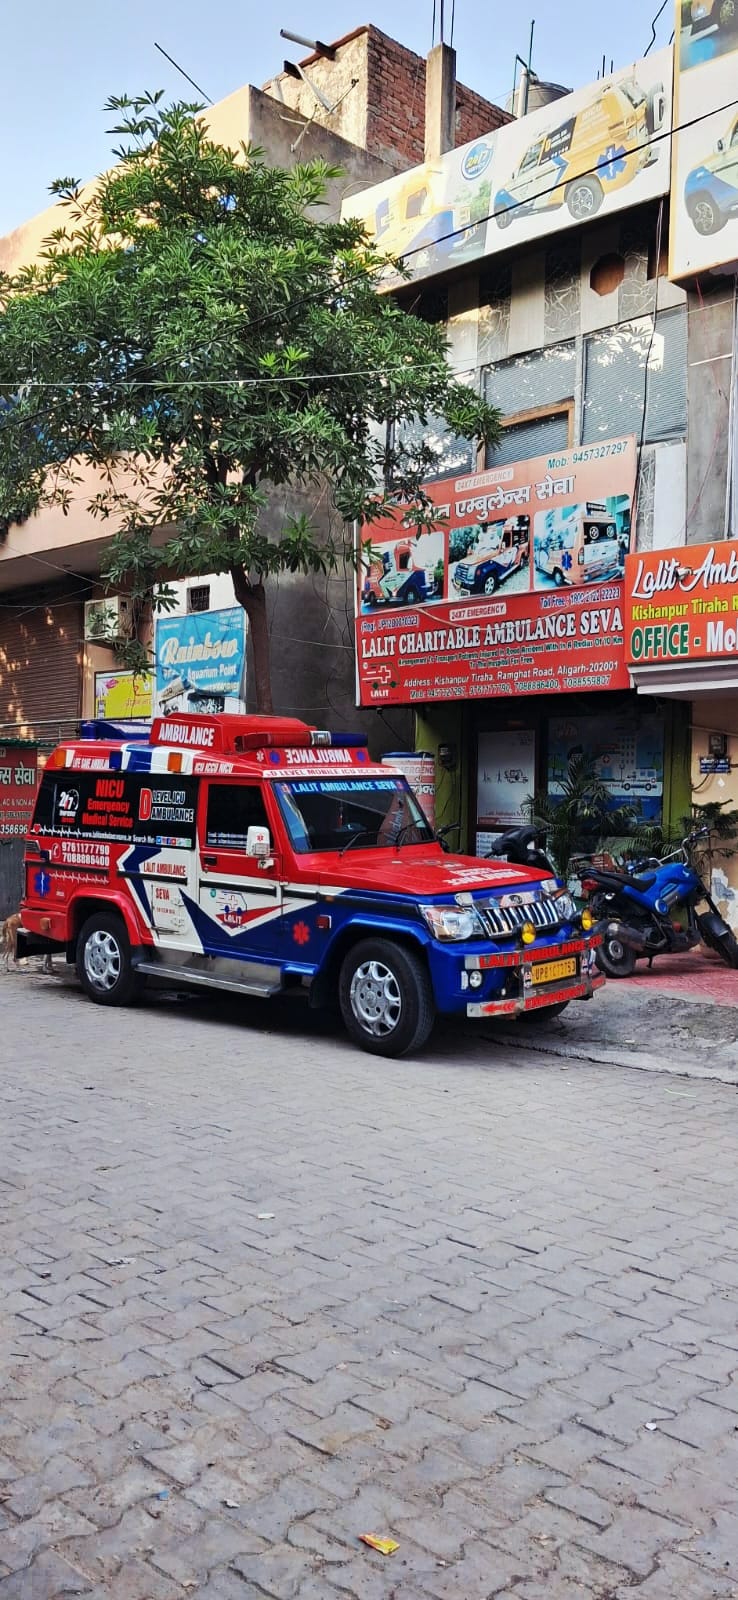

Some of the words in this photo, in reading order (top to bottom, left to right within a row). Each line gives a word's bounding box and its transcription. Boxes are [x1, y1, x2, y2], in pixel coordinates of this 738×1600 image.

[547, 458, 570, 469] Mob:
[572, 441, 628, 464] 9457327297
[473, 471, 511, 487] EMERGENCY
[535, 474, 576, 500] सेवा
[631, 558, 680, 599] Lalit
[467, 604, 505, 617] EMERGENCY
[632, 604, 689, 621] Kishanpur
[691, 597, 729, 614] Tiraha
[361, 635, 396, 658] LALIT
[399, 625, 480, 654] CHARITABLE
[484, 613, 576, 646] AMBULANCE
[580, 607, 624, 635] SEVA
[631, 622, 690, 660] OFFICE
[706, 619, 738, 653] Mo
[160, 632, 239, 665] Rainbow
[219, 663, 237, 676] Point
[434, 674, 470, 687] Kishanpur
[497, 669, 531, 682] Ramghat
[370, 689, 389, 698] LALIT
[158, 723, 215, 747] AMBULANCE
[14, 761, 35, 785] सेवा
[95, 778, 125, 798] NICU
[291, 782, 320, 793] LALIT
[320, 781, 375, 792] AMBULANCE
[375, 780, 397, 791] SEVA
[87, 798, 130, 814] Emergency
[139, 787, 152, 821] D
[151, 806, 194, 823] AMBULANCE
[61, 841, 110, 855] 9761177790
[143, 862, 157, 873] LALIT
[157, 863, 186, 876] AMBULANCE
[155, 887, 170, 900] SEVA
[223, 912, 242, 925] LALIT
[480, 953, 520, 968] LALIT
[523, 940, 585, 963] AMBULANCE
